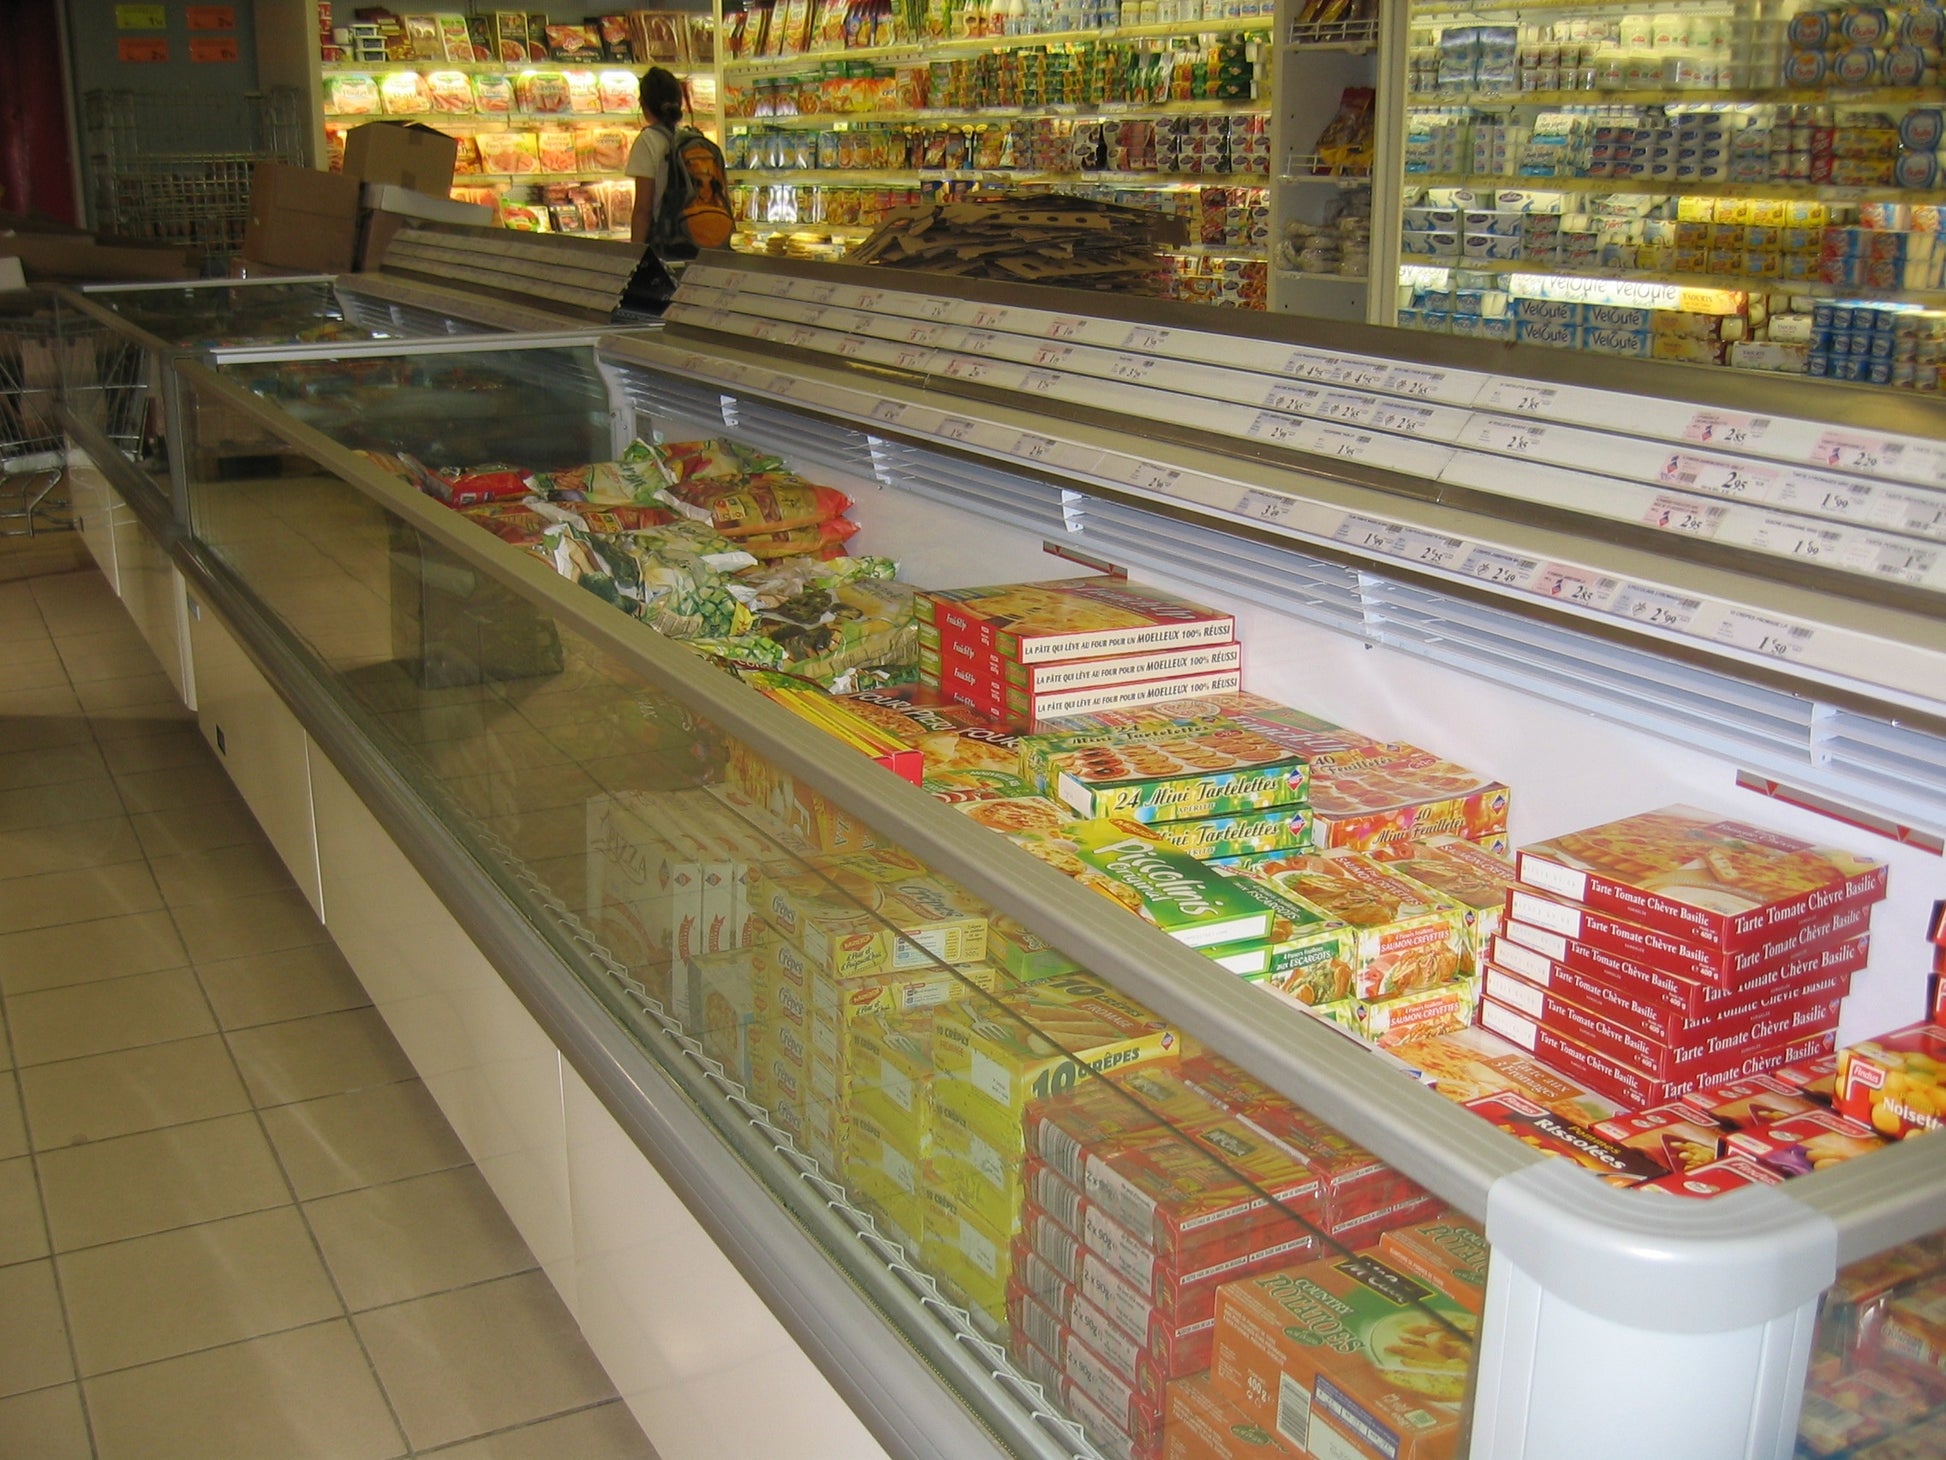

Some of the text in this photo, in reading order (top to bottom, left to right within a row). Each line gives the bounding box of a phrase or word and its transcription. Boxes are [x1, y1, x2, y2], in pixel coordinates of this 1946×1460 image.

[1025, 646, 1033, 654] LA
[1052, 644, 1064, 653] QUI
[1091, 640, 1107, 648] FOUR
[1109, 638, 1125, 646] POUR
[1137, 630, 1180, 643] MOELLEUX
[1182, 629, 1201, 639] 100%
[1204, 625, 1230, 636] RÉUSSI
[1036, 676, 1044, 684] LA
[1063, 674, 1074, 682] QUI
[1102, 668, 1116, 676] FOUR
[1119, 666, 1135, 674] POUR
[1146, 658, 1188, 671] MOELLEUX
[1190, 656, 1209, 666] 100%
[1212, 650, 1238, 662] RÉUSSI
[1064, 701, 1075, 710] QUI
[1102, 696, 1118, 704] FOUR
[1120, 694, 1136, 702] POUR
[1146, 685, 1188, 698] MOELLEUX
[1190, 683, 1209, 692] 100%
[1212, 677, 1238, 689] RÉUSSI
[1315, 756, 1336, 764] 40
[1114, 776, 1278, 810] 24 Mini Tartelettes
[1195, 820, 1278, 845] Tartelettes
[1373, 818, 1466, 845] Mini Feuilletés
[1414, 808, 1432, 822] 40
[1093, 838, 1224, 916] Piccolinis
[1106, 861, 1168, 902] Original
[1591, 879, 1612, 895] Tarte
[1614, 887, 1646, 906] Tomate
[1648, 898, 1678, 916] Chèvre
[1680, 908, 1709, 926] Basilic
[1735, 874, 1876, 934] Tarte Tomate Chèvre Basilic
[1290, 951, 1330, 968] ESCARGOTS
[1586, 916, 1608, 932] Tarte
[1610, 924, 1643, 944] Tomate
[1645, 935, 1677, 954] Chèvre
[1680, 945, 1709, 964] Basilic
[1735, 908, 1860, 971] Tarte Tomate Chèvre Basilic
[1822, 944, 1854, 968] Basilic
[1049, 980, 1104, 996] 10
[1570, 942, 1590, 958] Tarte
[1592, 950, 1620, 969] Tomate
[1622, 962, 1650, 982] Chèvre
[1652, 975, 1678, 993] Basilic
[1554, 966, 1572, 982] Tarte
[1574, 975, 1601, 996] Tomate
[1603, 989, 1629, 1008] Chèvre
[1631, 1002, 1657, 1020] Basilic
[1082, 1004, 1134, 1028] FROMAGE
[1547, 999, 1650, 1054] Tarte Tomate Chèvre Basilic
[1674, 1006, 1827, 1064] Tarte Tomate Chèvre Basilic
[1032, 1047, 1140, 1098] 10 CRÊPES
[1540, 1032, 1638, 1088] Tarte Tomate Chèvre Basilic
[1662, 1040, 1820, 1100] Tarte Tomate Chèvre Basilic
[1534, 1118, 1626, 1170] Rissolées
[1254, 1274, 1365, 1354] POTATOES
[1296, 1278, 1354, 1314] COUNTRY
[1248, 1376, 1261, 1392] 400
